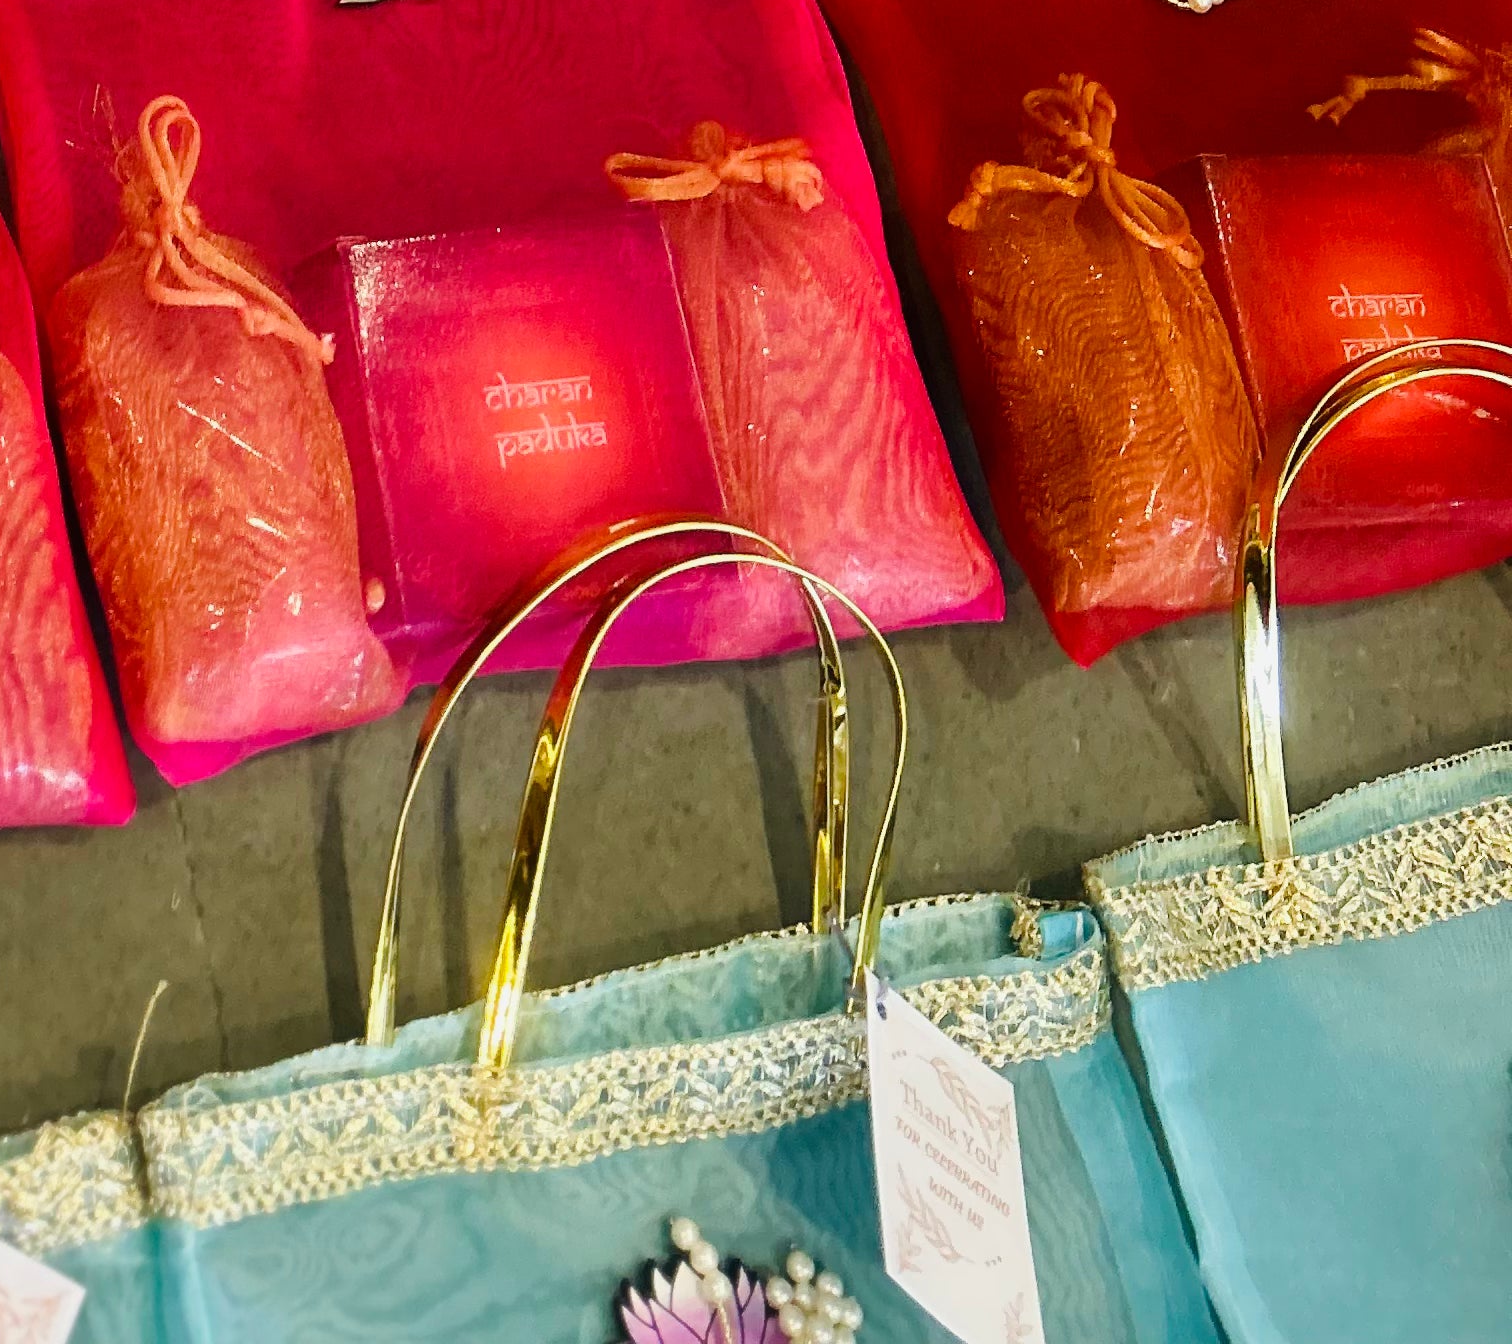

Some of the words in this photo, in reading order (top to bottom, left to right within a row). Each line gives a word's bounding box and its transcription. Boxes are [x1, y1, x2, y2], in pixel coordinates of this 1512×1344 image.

[1328, 283, 1427, 318] charan
[483, 372, 593, 411] charan
[493, 411, 608, 470] paduka
[898, 1079, 959, 1145] Thank
[962, 1128, 999, 1177] You
[928, 1175, 965, 1216] WITH
